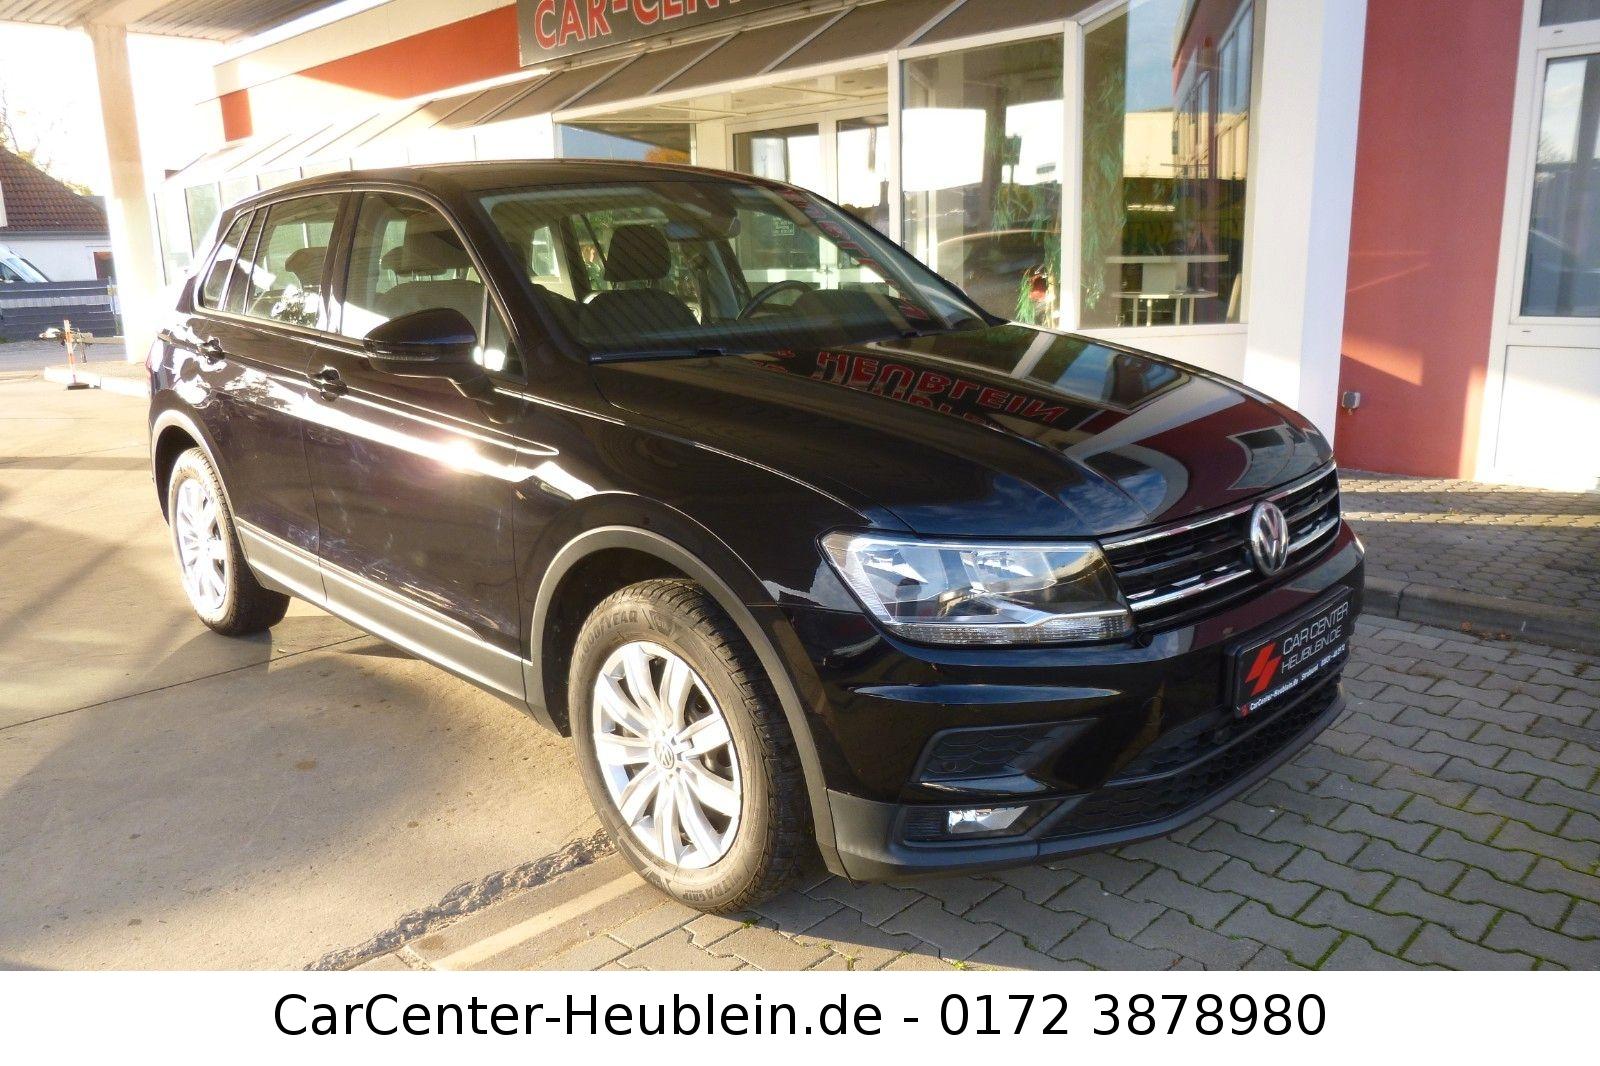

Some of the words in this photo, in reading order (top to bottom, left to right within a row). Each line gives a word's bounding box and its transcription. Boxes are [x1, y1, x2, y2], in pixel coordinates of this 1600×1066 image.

[533, 0, 741, 50] CAR-C
[1283, 628, 1309, 655] CAR
[1310, 601, 1348, 639] CENTER
